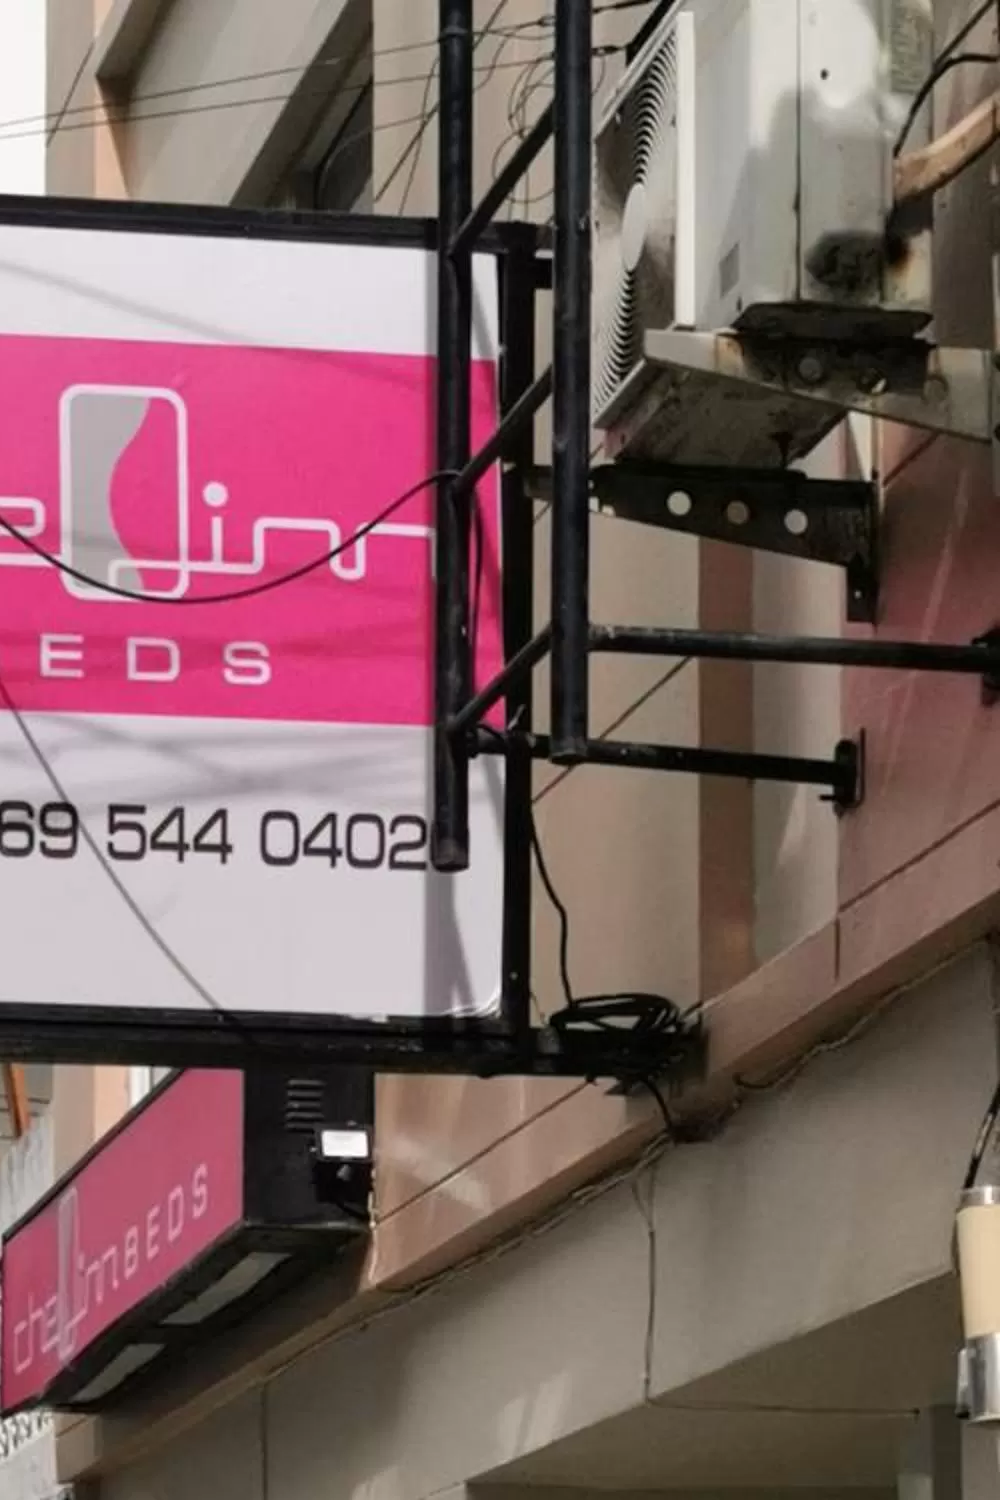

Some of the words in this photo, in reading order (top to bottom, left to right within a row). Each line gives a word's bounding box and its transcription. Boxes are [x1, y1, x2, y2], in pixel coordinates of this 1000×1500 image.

[107, 804, 233, 866] 544
[259, 809, 428, 871] 0402
[123, 1163, 209, 1281] BEDS
